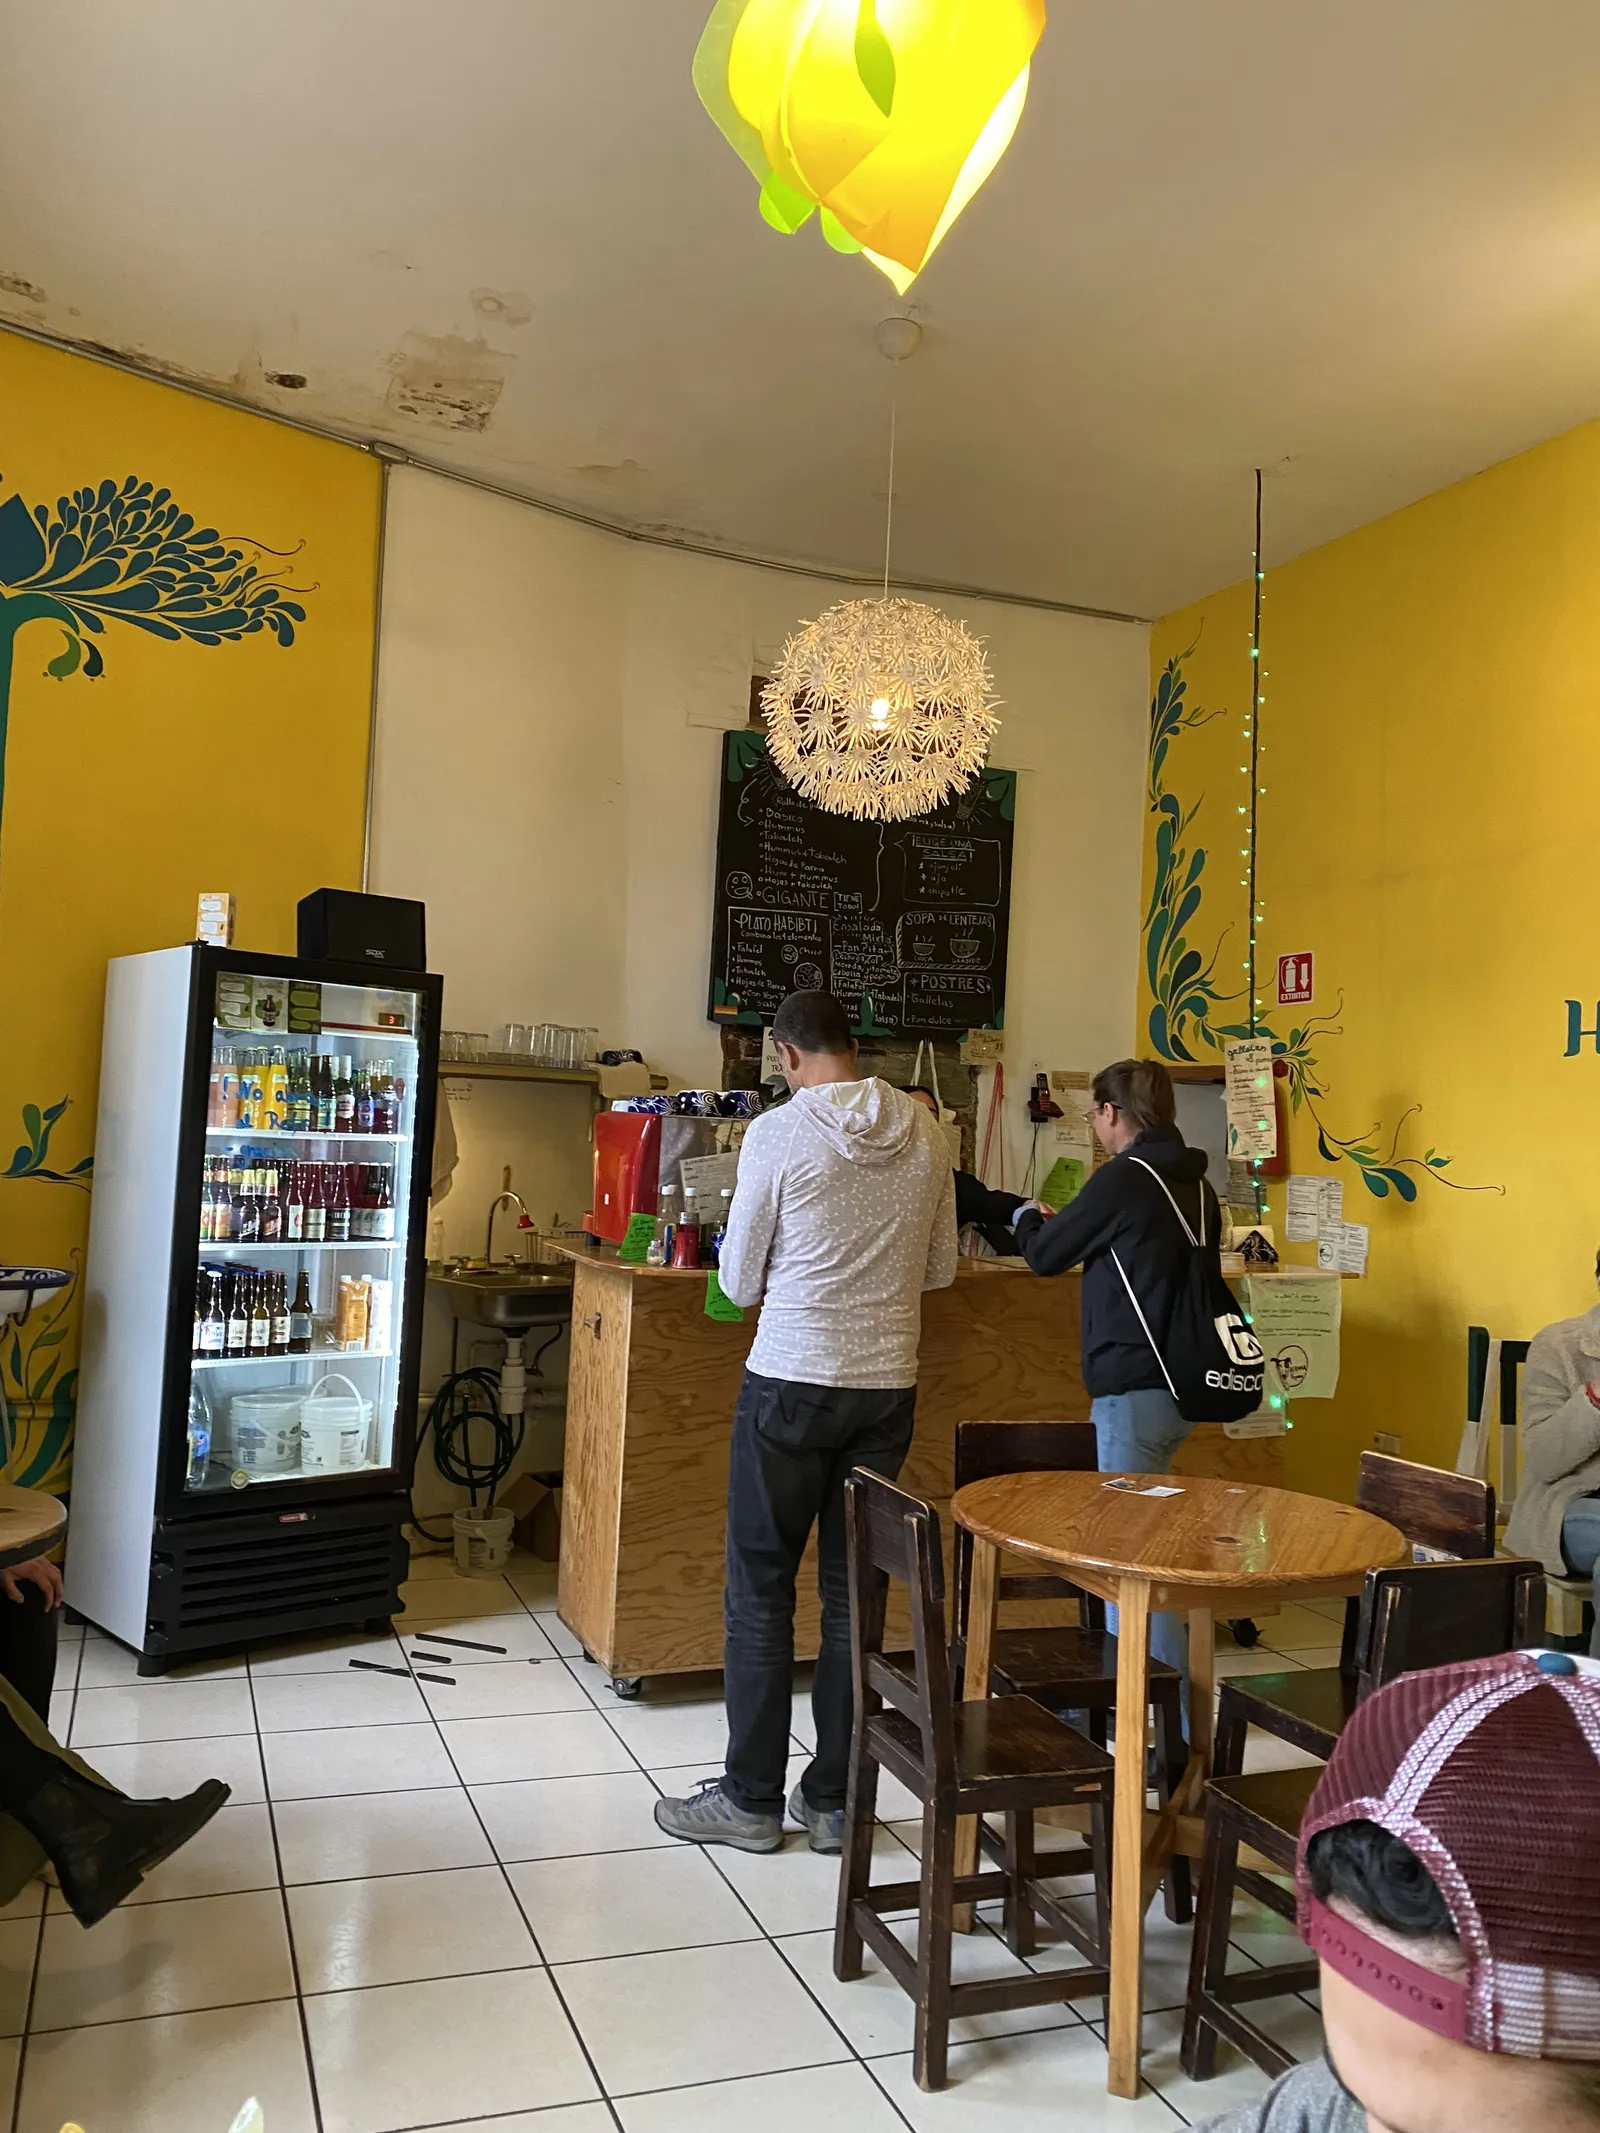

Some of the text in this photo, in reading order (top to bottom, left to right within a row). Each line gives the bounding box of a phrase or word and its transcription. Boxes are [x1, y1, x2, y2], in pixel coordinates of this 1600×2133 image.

[766, 808, 803, 823] Básico
[764, 819, 805, 834] Hummus
[764, 841, 801, 856] Hummus
[950, 838, 972, 849] UNA
[800, 861, 825, 873] Parra
[764, 876, 788, 886] Hojas
[799, 872, 838, 884] Hummus
[930, 875, 947, 884] ajo
[762, 886, 829, 909] GIGANTE
[928, 885, 967, 898] chipotle
[737, 912, 817, 934] PLATO HABIBTI
[833, 918, 882, 933] Ensalada
[905, 912, 936, 926] SOPA
[949, 914, 992, 928] LENTEJAS
[862, 930, 892, 945] Mixta
[736, 941, 763, 954] Falafel
[842, 940, 884, 955] Pan Pita
[766, 979, 787, 991] Parra
[920, 974, 986, 994] POSTRES
[911, 993, 954, 1008] Galletas
[1281, 991, 1310, 1001] EXTINTOR
[756, 1000, 780, 1009] sals
[911, 1014, 952, 1025] Pan dulce
